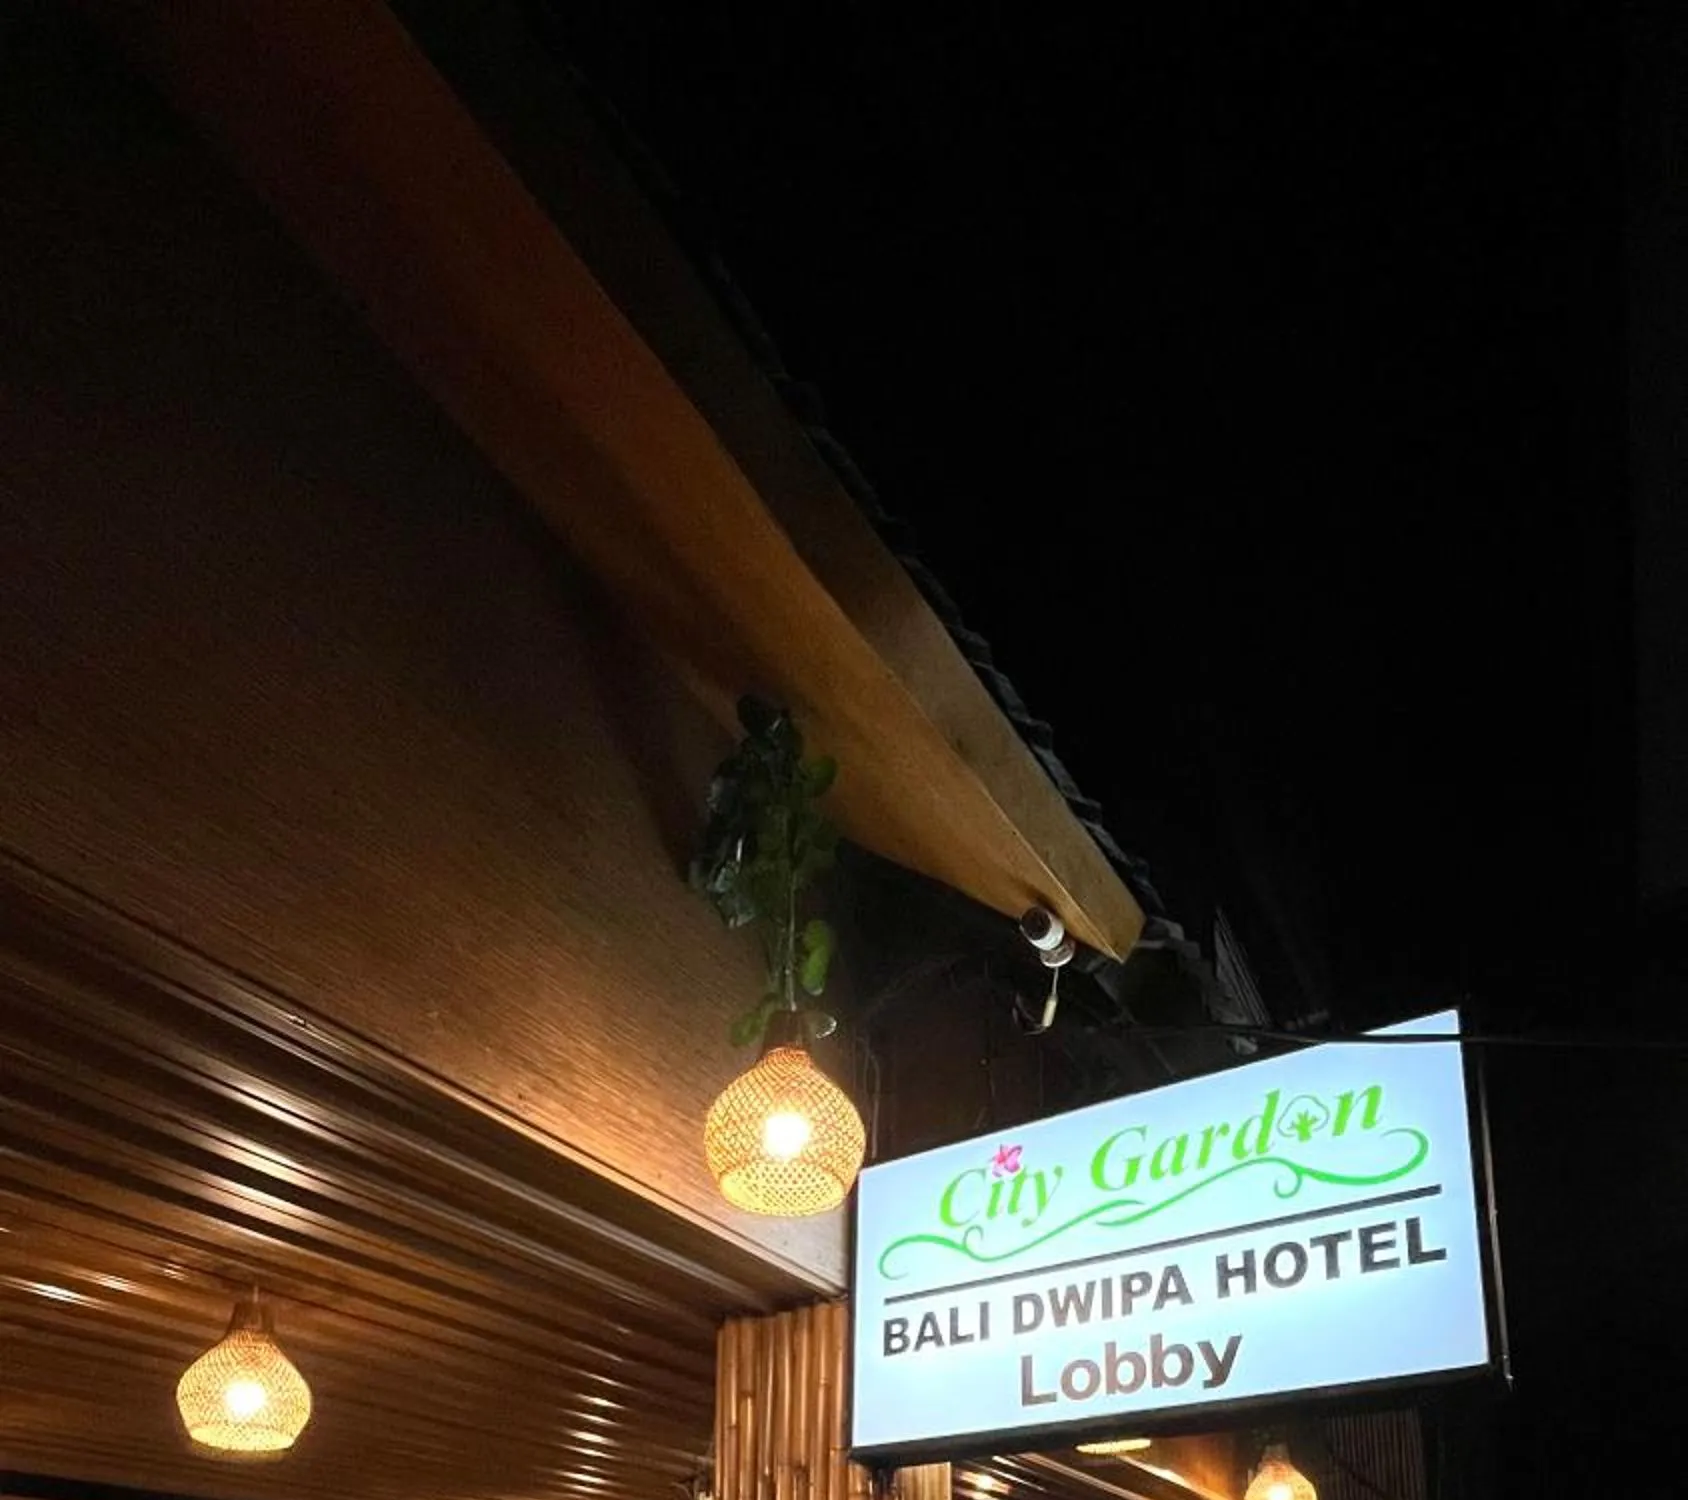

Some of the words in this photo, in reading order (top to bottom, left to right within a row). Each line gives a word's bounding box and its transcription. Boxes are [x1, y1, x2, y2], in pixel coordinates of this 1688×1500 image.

[939, 1144, 1063, 1227] City
[883, 1302, 991, 1357] BALI
[1012, 1264, 1194, 1335] DWIPA
[1215, 1217, 1447, 1298] HOTEL
[1021, 1333, 1242, 1408] Lobby
